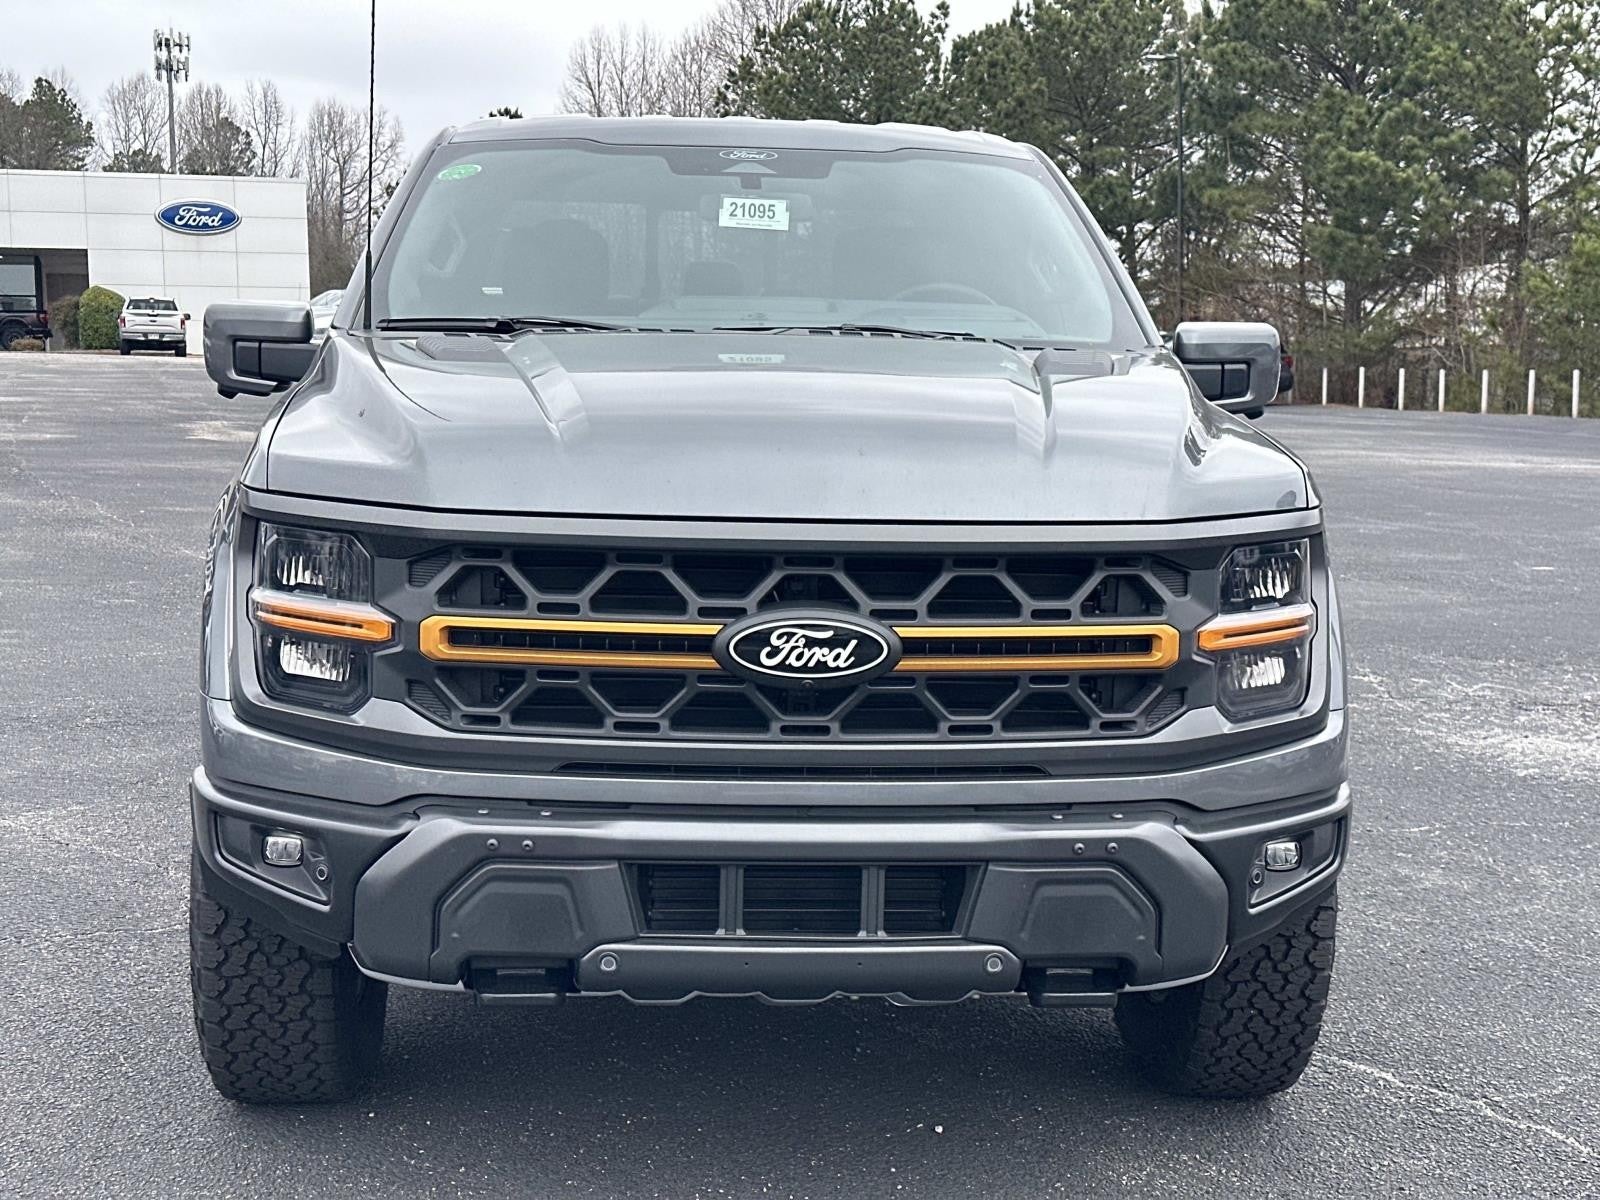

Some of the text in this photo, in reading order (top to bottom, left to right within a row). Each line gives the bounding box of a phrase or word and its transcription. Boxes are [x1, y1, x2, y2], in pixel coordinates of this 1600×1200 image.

[730, 150, 767, 159] Ford
[174, 205, 222, 226] Ford
[729, 201, 776, 219] 21095
[760, 627, 858, 668] Ford
